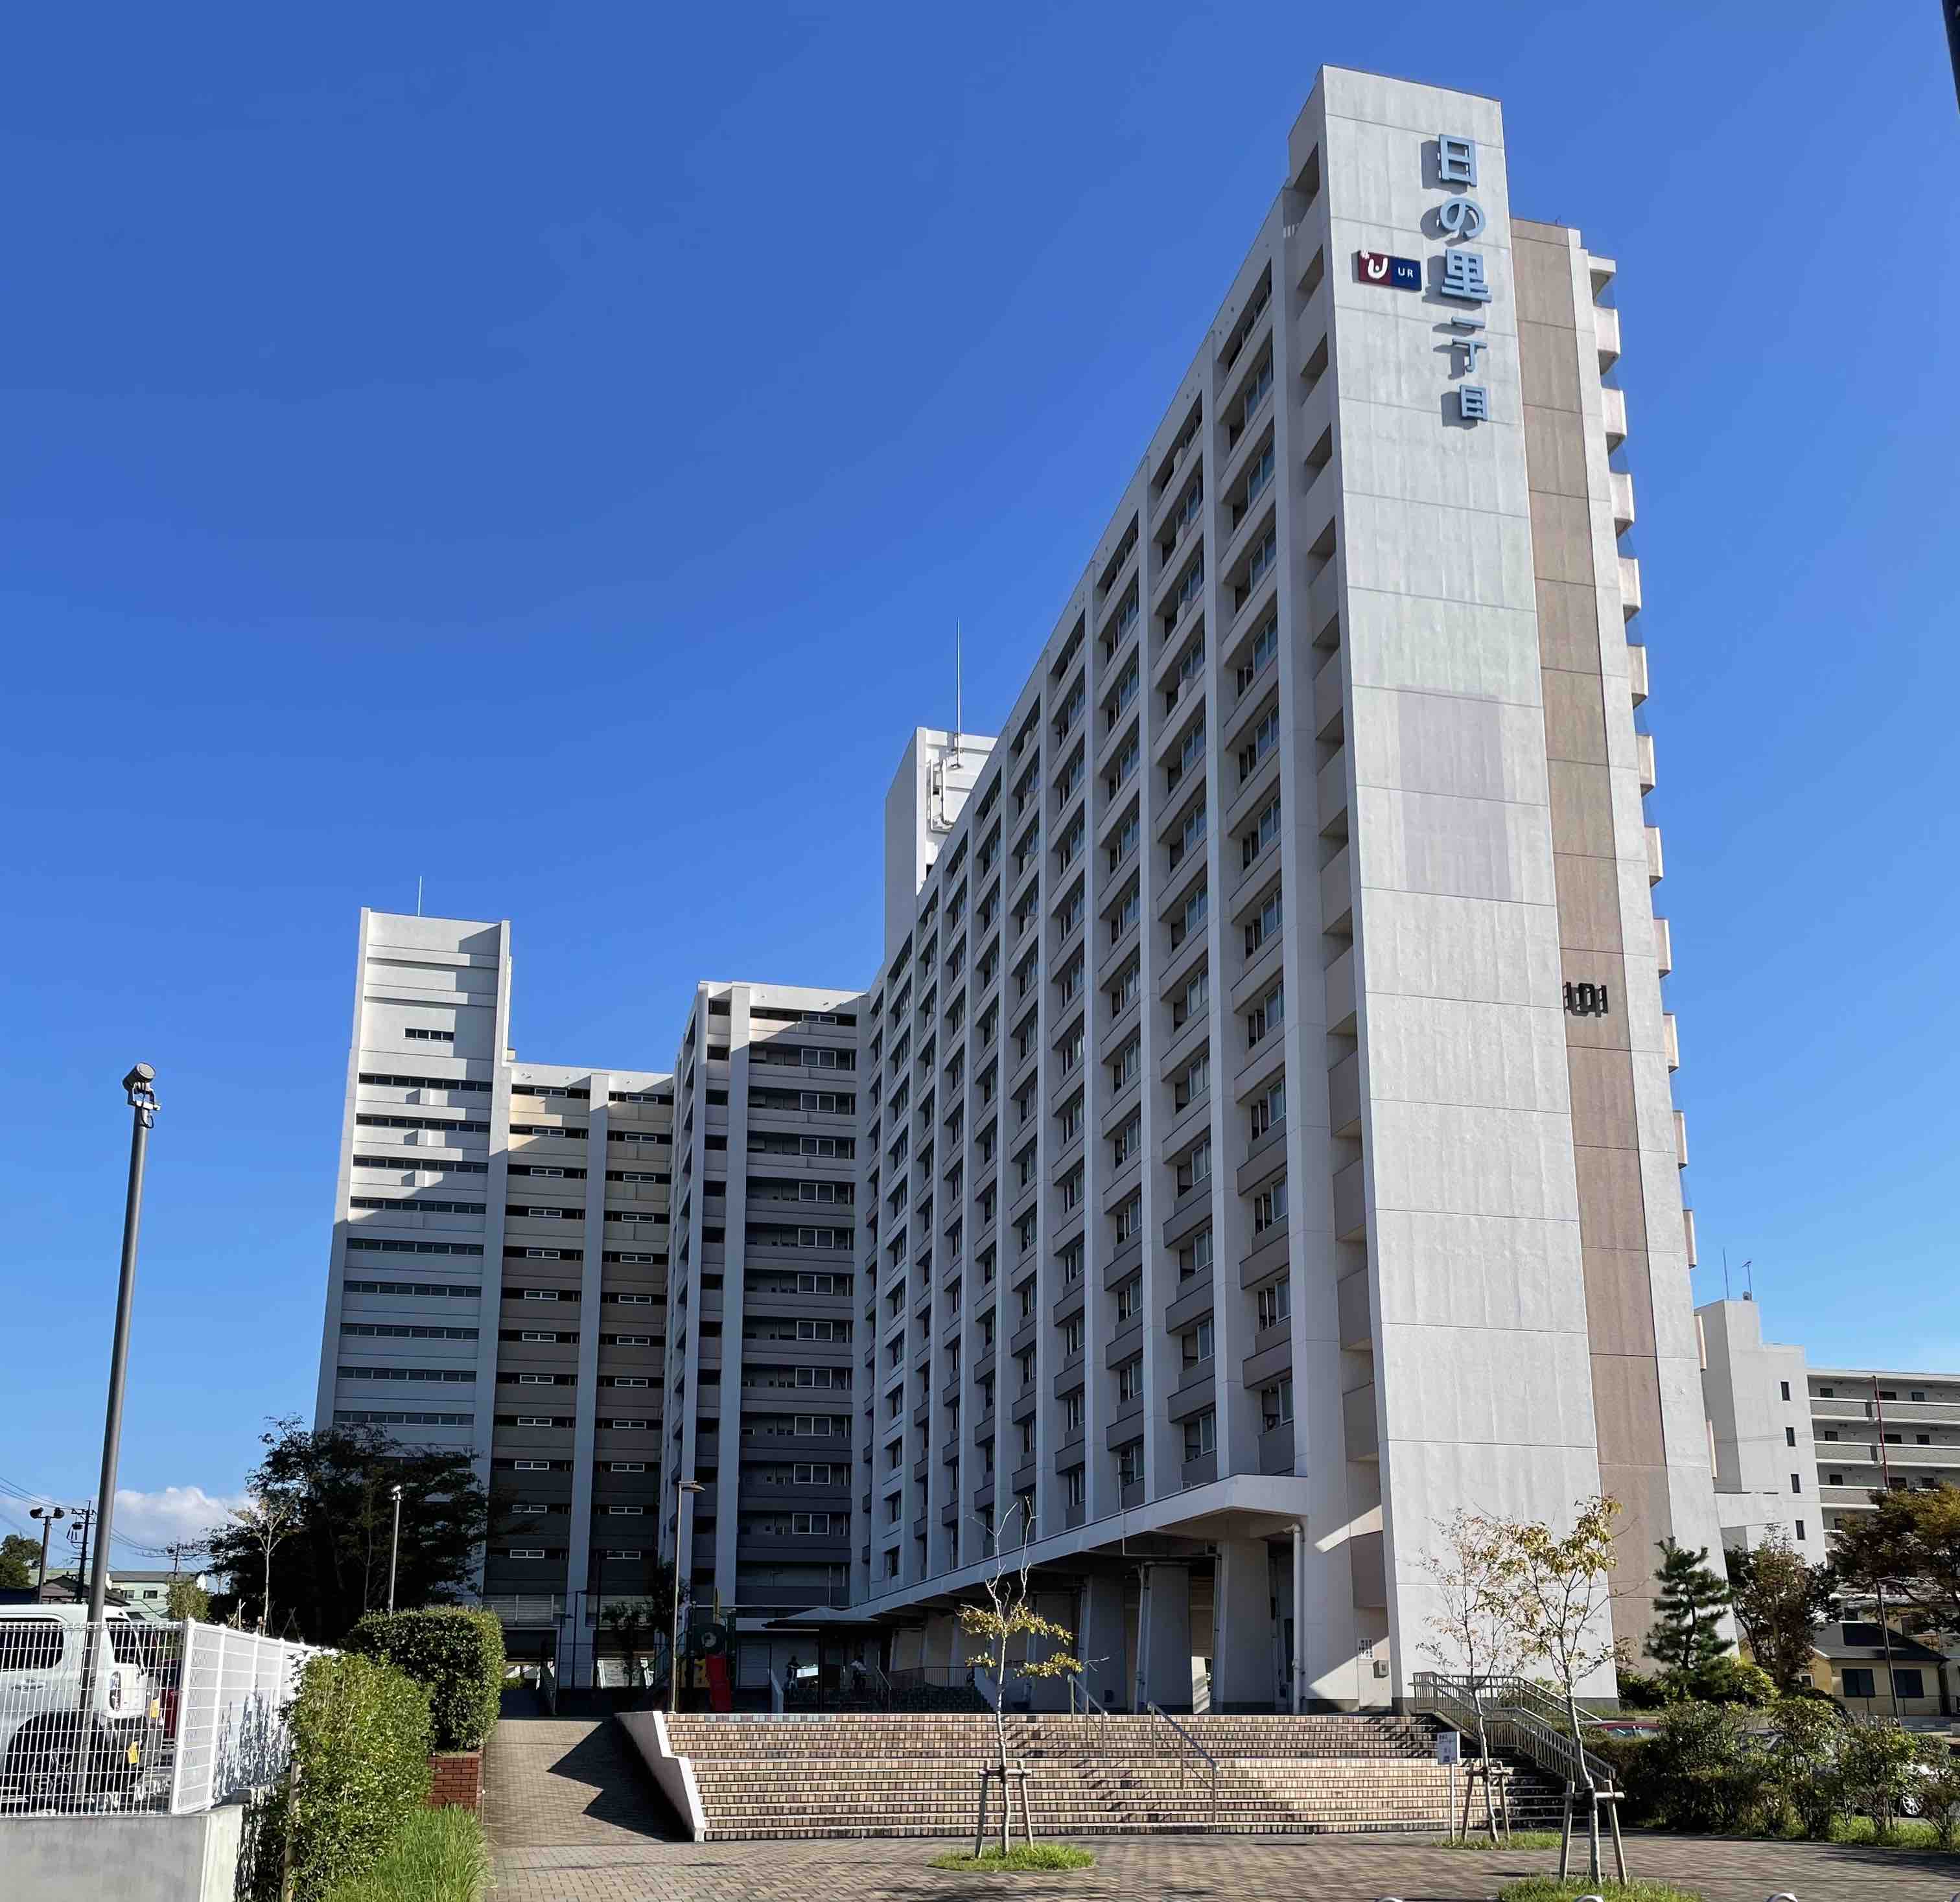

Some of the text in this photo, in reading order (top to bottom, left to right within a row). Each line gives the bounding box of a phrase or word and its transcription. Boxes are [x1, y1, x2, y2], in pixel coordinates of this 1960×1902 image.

[1397, 266, 1414, 278] UR
[1439, 133, 1492, 421] 日の里一丁目
[1565, 981, 1608, 1014] 101
